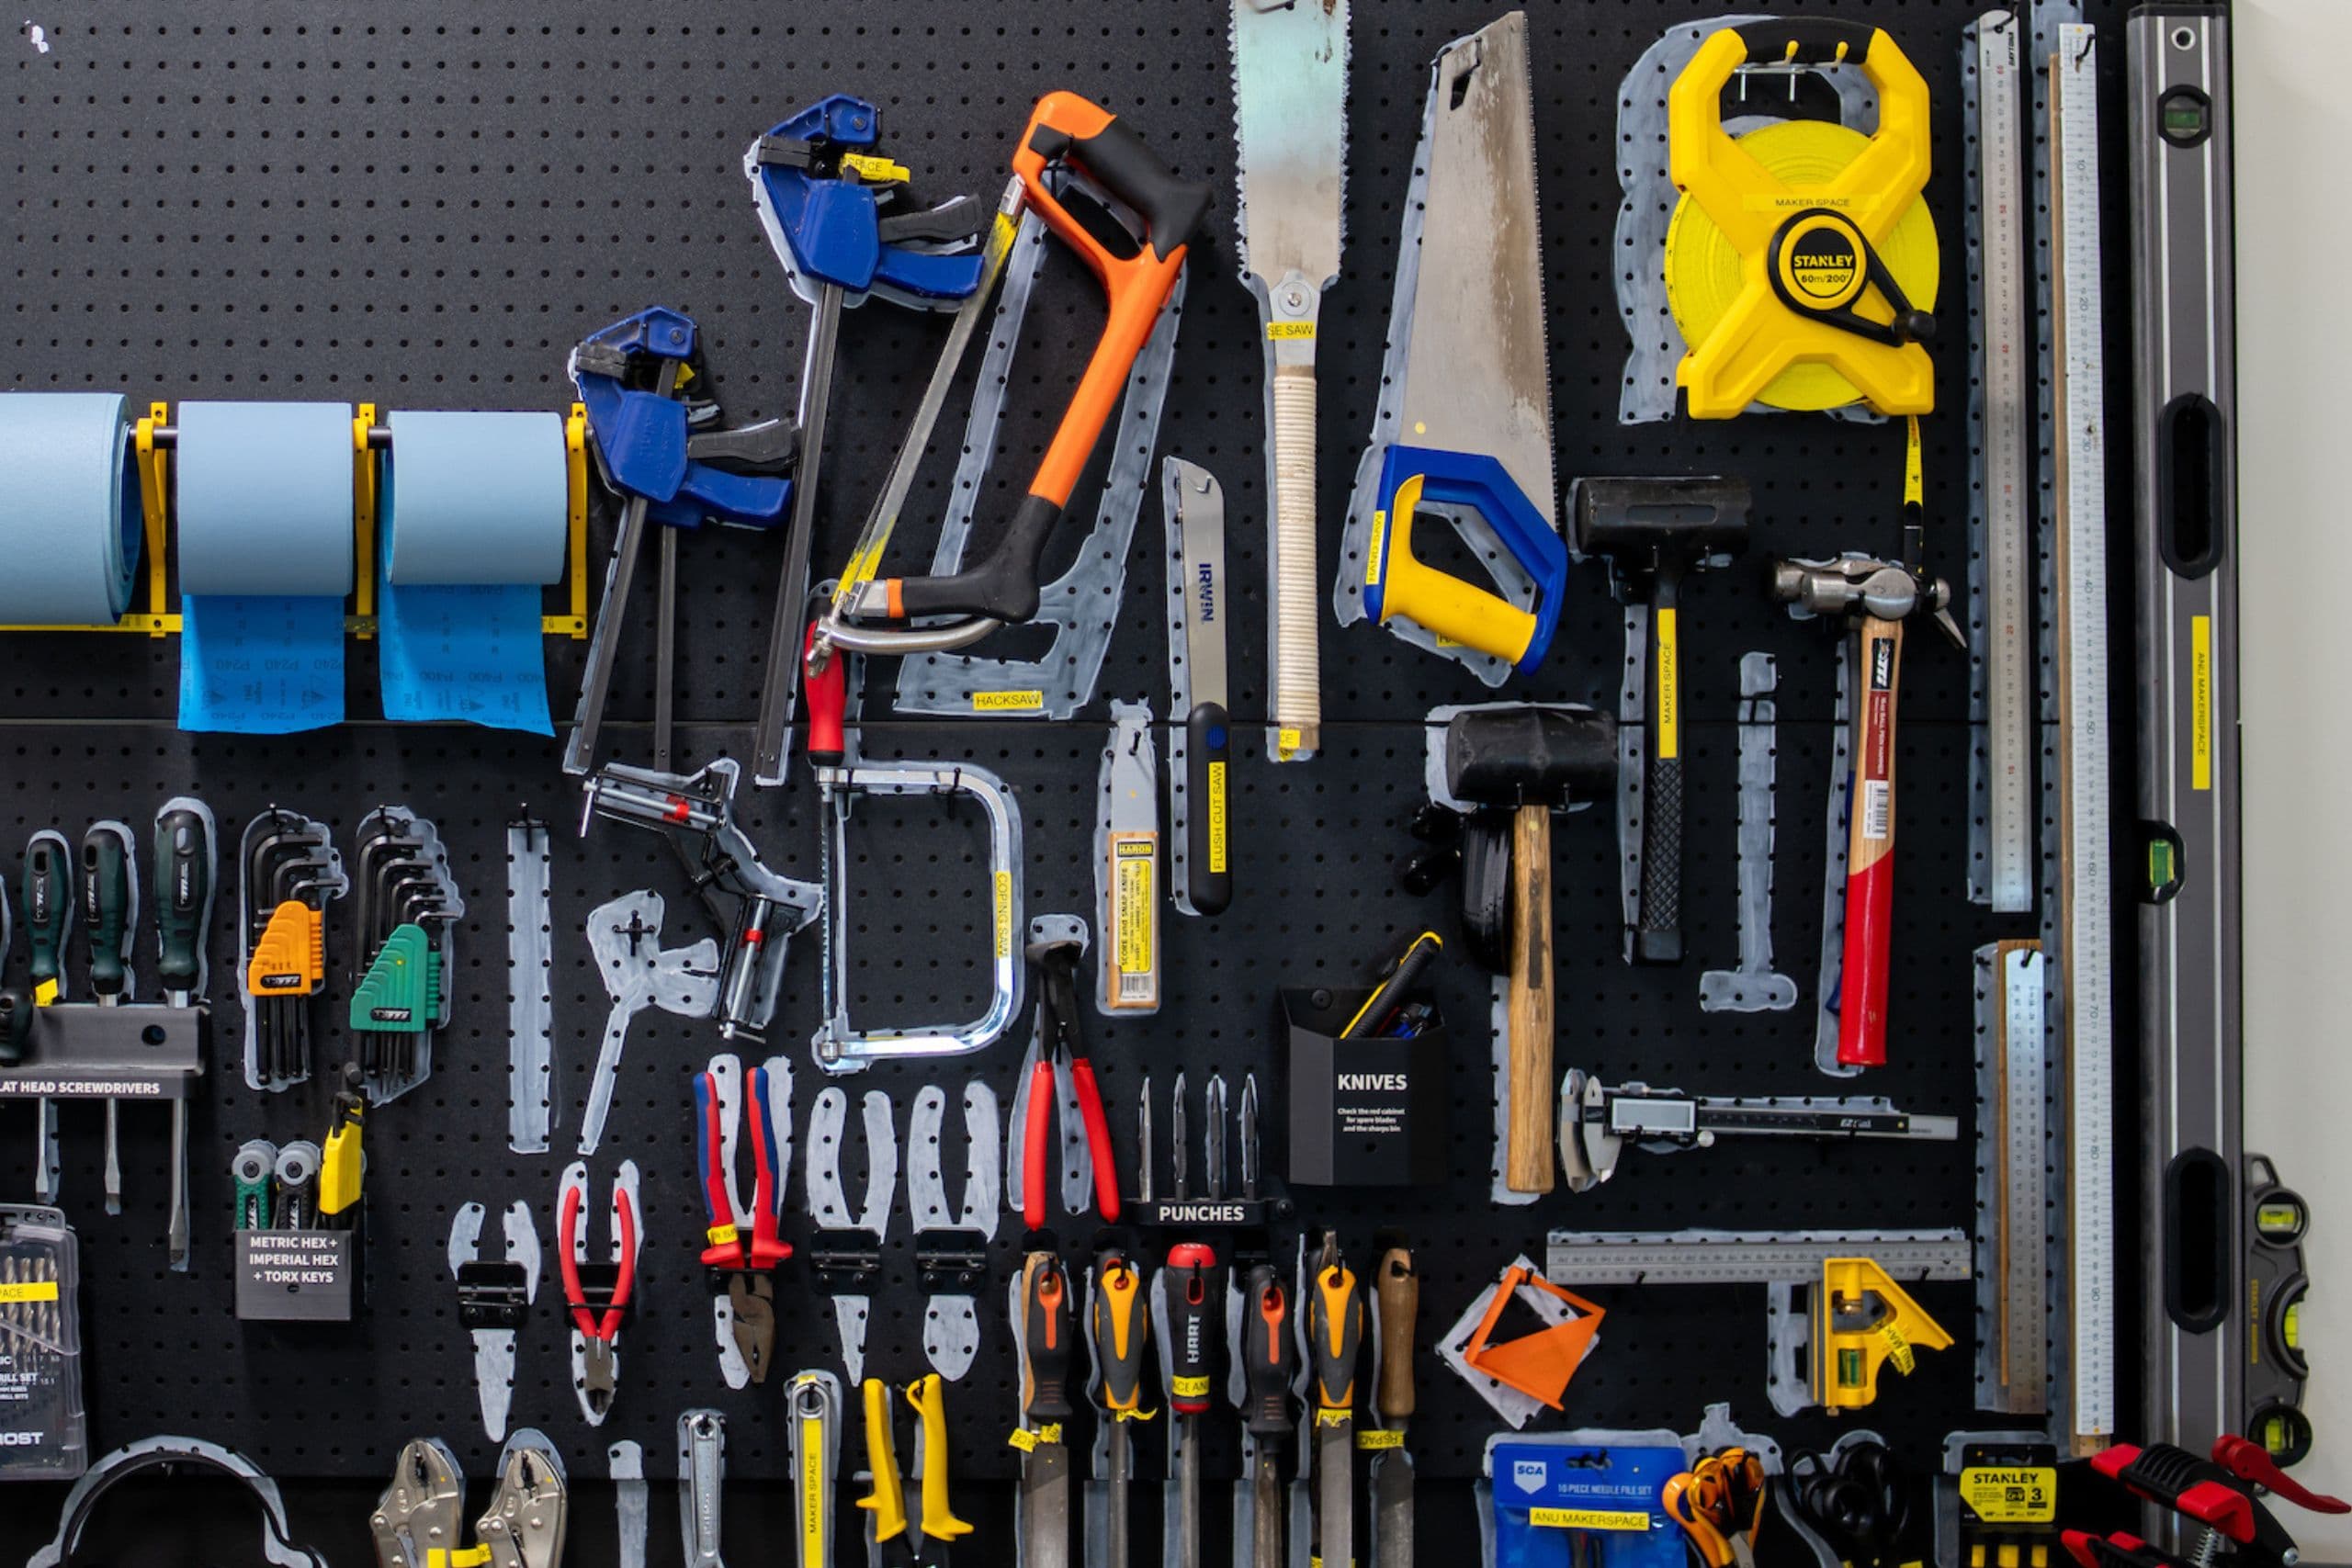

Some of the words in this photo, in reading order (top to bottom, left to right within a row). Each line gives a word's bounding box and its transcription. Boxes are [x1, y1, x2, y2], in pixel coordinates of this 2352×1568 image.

[2076, 160, 2086, 171] 10
[1793, 254, 1854, 267] STANLEY
[2080, 298, 2088, 311] 20
[1286, 325, 1314, 336] SAW
[2083, 438, 2091, 452] 30
[1199, 563, 1214, 621] IRWIN
[2085, 580, 2093, 593] 40
[1663, 642, 1672, 680] SPACE
[2198, 651, 2206, 674] ANU
[977, 694, 1040, 705] HACKSAW
[1663, 683, 1672, 724] MAKER
[2197, 677, 2206, 756] MAKERSPACE
[2086, 721, 2095, 735] 50
[1212, 764, 1222, 795] SAW
[1212, 798, 1222, 824] CUT
[1212, 827, 1223, 869] FLUSH
[2088, 862, 2097, 876] 60
[998, 874, 1009, 924] COPING
[2089, 1005, 2098, 1019] 70
[20, 1082, 55, 1093] HEAD
[59, 1082, 160, 1094] SCREWDRIVERS
[1338, 1074, 1408, 1091] KNIVES
[2090, 1145, 2099, 1159] 80
[1159, 1205, 1244, 1222] PUNCHES
[250, 1236, 300, 1247] METRIC
[301, 1237, 327, 1249] HEX
[329, 1239, 338, 1247] +
[250, 1254, 310, 1265] IMPERIAL
[312, 1255, 338, 1266] HEX
[254, 1272, 263, 1280] +
[265, 1271, 300, 1282] TORX
[301, 1271, 334, 1283] KEYS
[0, 1287, 23, 1298] ACE
[2092, 1287, 2099, 1302] 90
[1187, 1314, 1202, 1363] HART
[20, 1372, 39, 1382] SET
[0, 1432, 44, 1446] OST
[808, 1452, 818, 1492] SPACE
[1517, 1466, 1544, 1475] SCA
[1973, 1473, 2039, 1484] STANLEY
[1568, 1484, 1589, 1495] PIECE
[1591, 1484, 1619, 1495] NEEDLE
[1621, 1486, 1637, 1495] FILE
[1637, 1486, 1652, 1495] SET
[2030, 1488, 2041, 1501] 3
[808, 1493, 818, 1534] MAKER
[1534, 1511, 1559, 1523] ANU
[1562, 1512, 1645, 1527] MAKERSPACE
